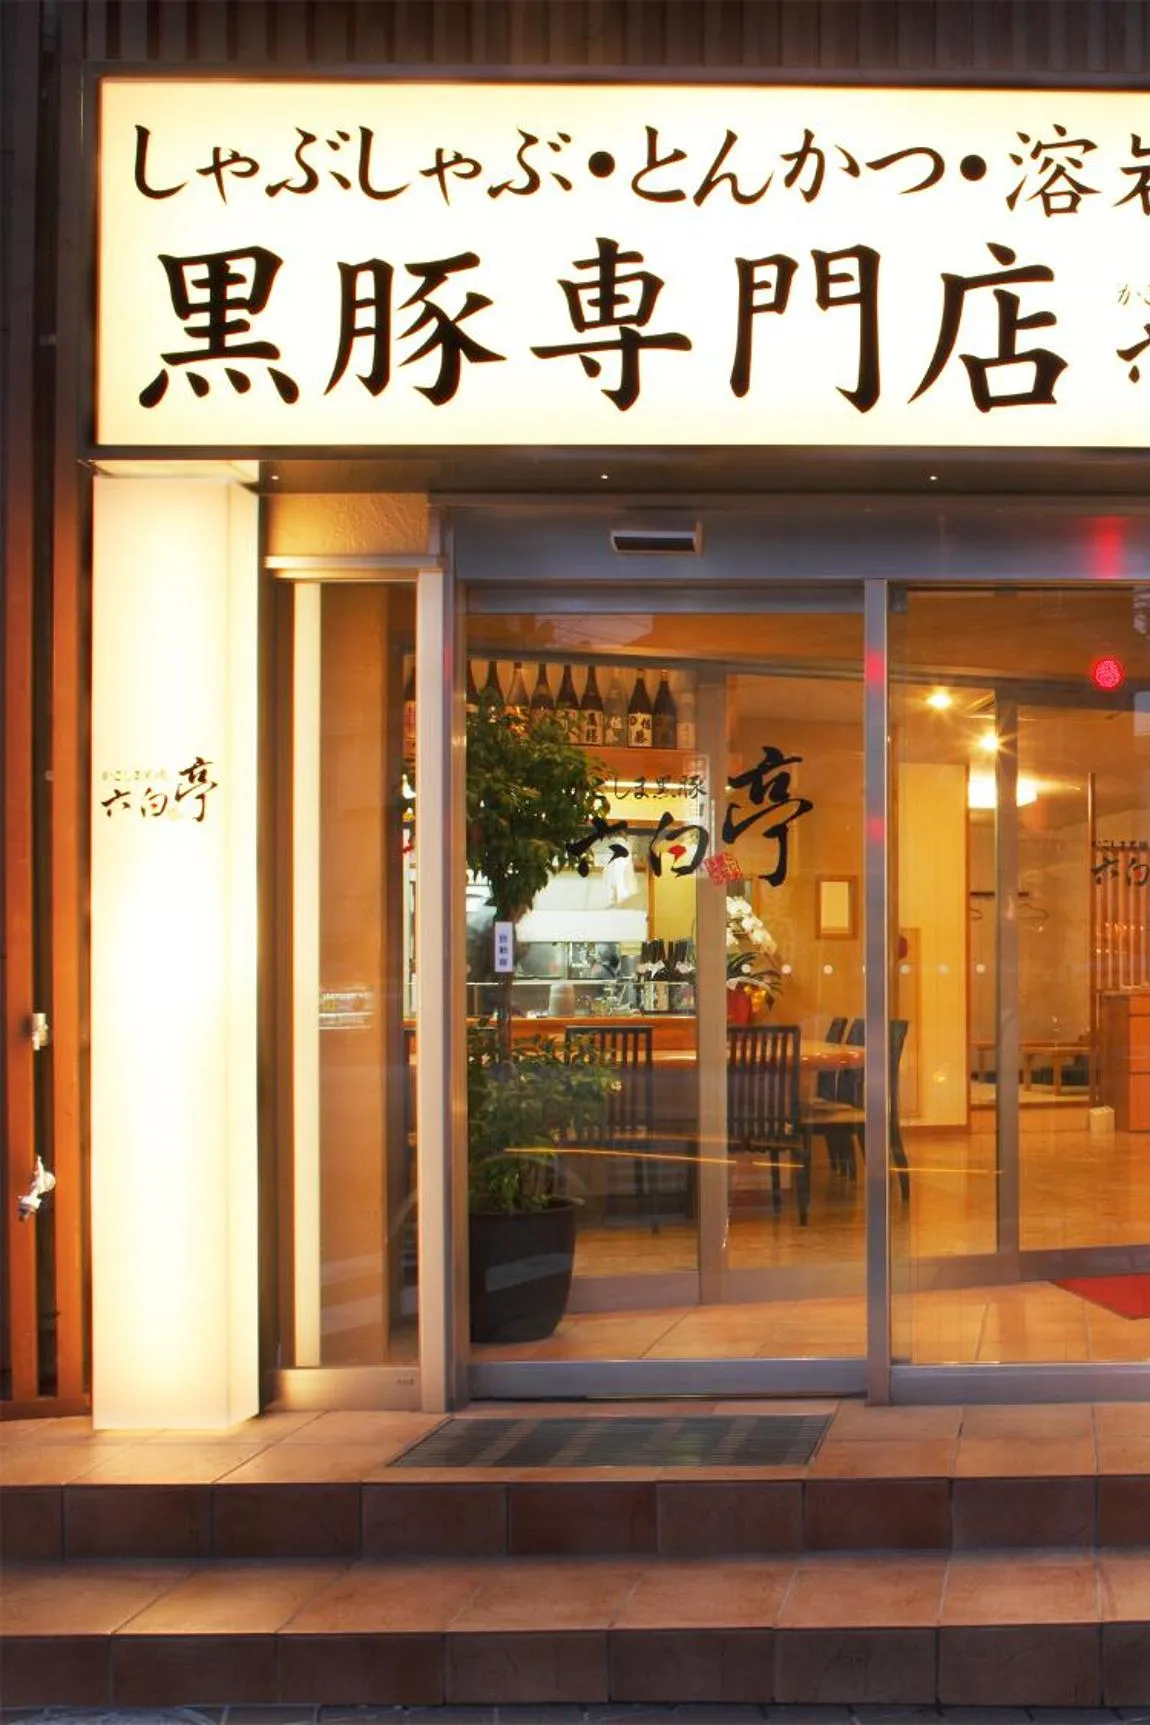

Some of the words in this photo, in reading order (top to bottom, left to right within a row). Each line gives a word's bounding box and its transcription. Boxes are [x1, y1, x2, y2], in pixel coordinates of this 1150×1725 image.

[138, 236, 1070, 415] 黒豚専門店
